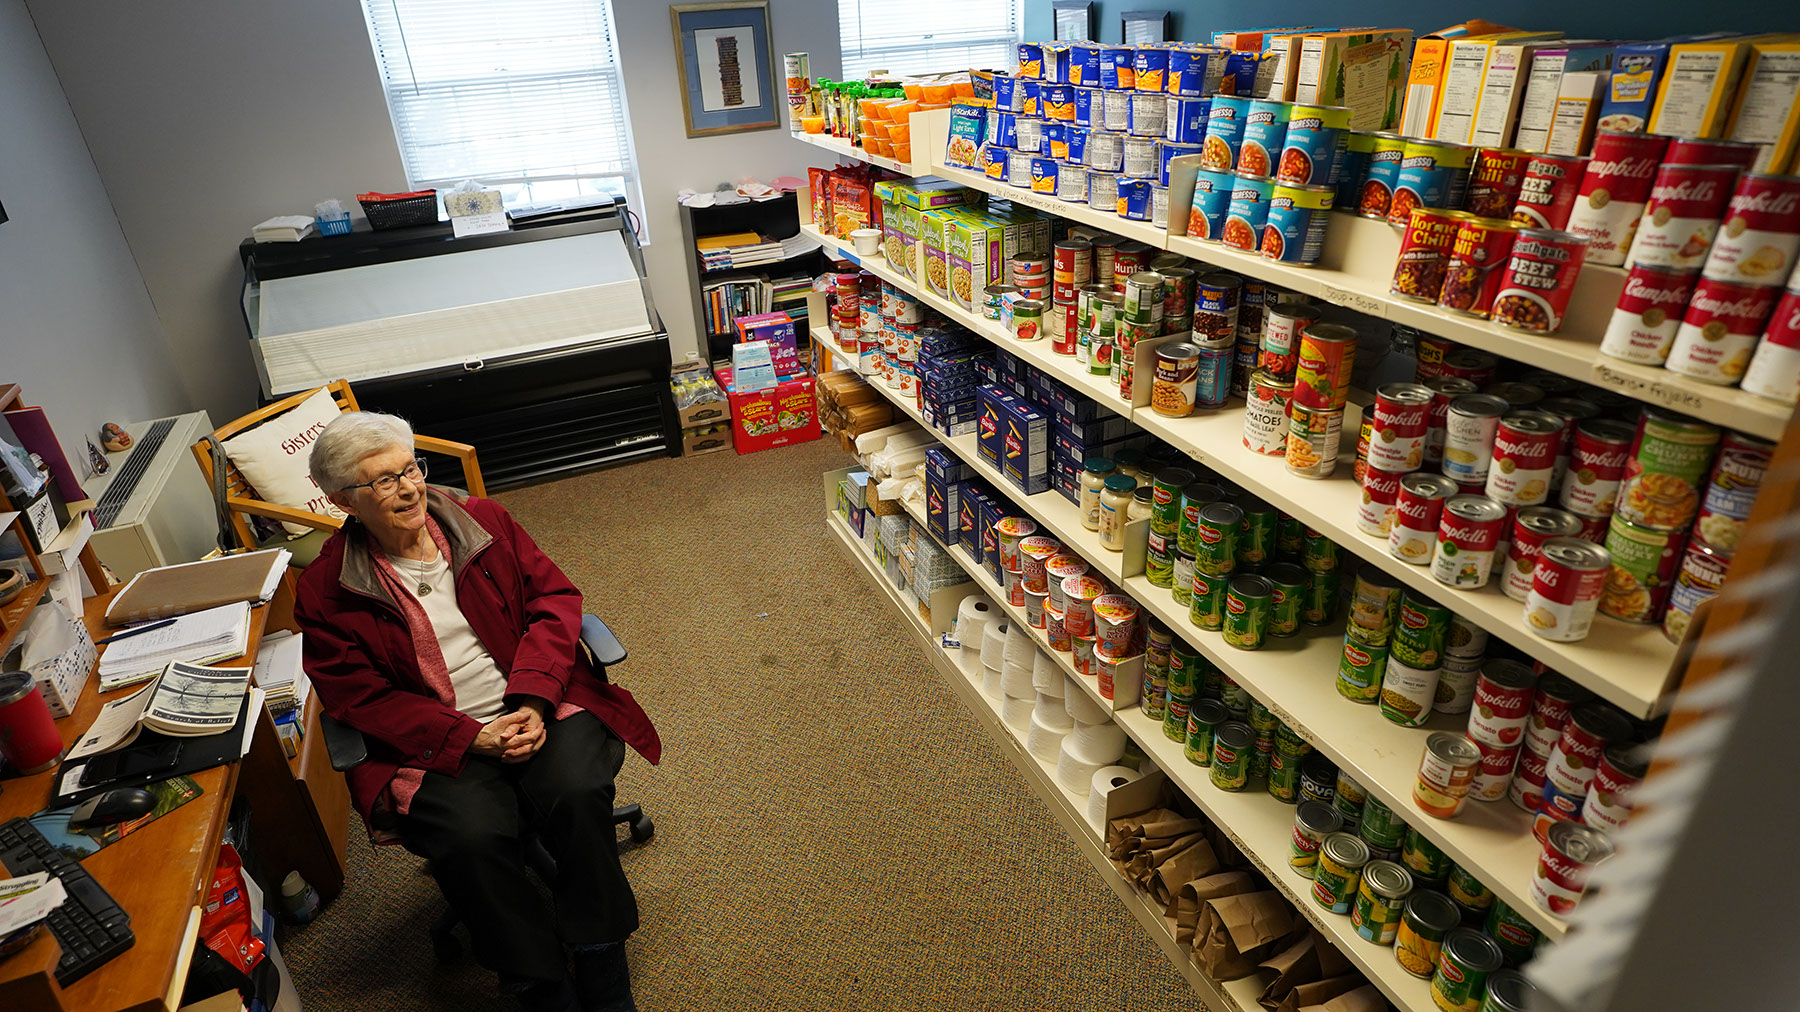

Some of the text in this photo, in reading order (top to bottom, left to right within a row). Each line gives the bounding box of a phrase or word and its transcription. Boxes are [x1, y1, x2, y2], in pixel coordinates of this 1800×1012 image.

[1484, 156, 1518, 170] rmel
[1586, 156, 1655, 179] ampbell's
[1478, 168, 1503, 182] hili
[1522, 176, 1552, 192] EEF
[1410, 215, 1458, 234] Horme
[1412, 230, 1450, 247] Chili
[1457, 228, 1487, 243] rmel
[1454, 238, 1473, 255] hili
[1513, 240, 1570, 262] Southgate
[1590, 240, 1616, 251] oodle
[1509, 256, 1555, 276] BEEF
[1513, 272, 1558, 290] STEW
[1354, 298, 1380, 311] Sopa
[1629, 338, 1658, 350] Noodle
[1630, 330, 1662, 342] Chicken
[1690, 344, 1724, 357] Chicken
[1688, 352, 1719, 366] Noodle
[980, 418, 996, 432] Barilla
[1262, 425, 1275, 433] LEAF
[281, 422, 326, 455] Sisters
[1006, 436, 1021, 451] Barilla
[1494, 440, 1548, 458] ampbell's
[1721, 458, 1766, 478] CHUN
[1206, 531, 1220, 539] Monte
[1439, 520, 1488, 544] ampbell's
[1684, 558, 1726, 584] CHUNK
[1409, 614, 1427, 626] Monte
[1353, 652, 1370, 663] Monte
[1476, 686, 1522, 709] ampbell's
[166, 714, 192, 722] Search
[1473, 717, 1496, 734] Tomato
[1555, 765, 1584, 785] Tomato
[1301, 774, 1334, 797] GOYA
[1589, 802, 1618, 826] Tomato
[0, 877, 40, 891] Struggling
